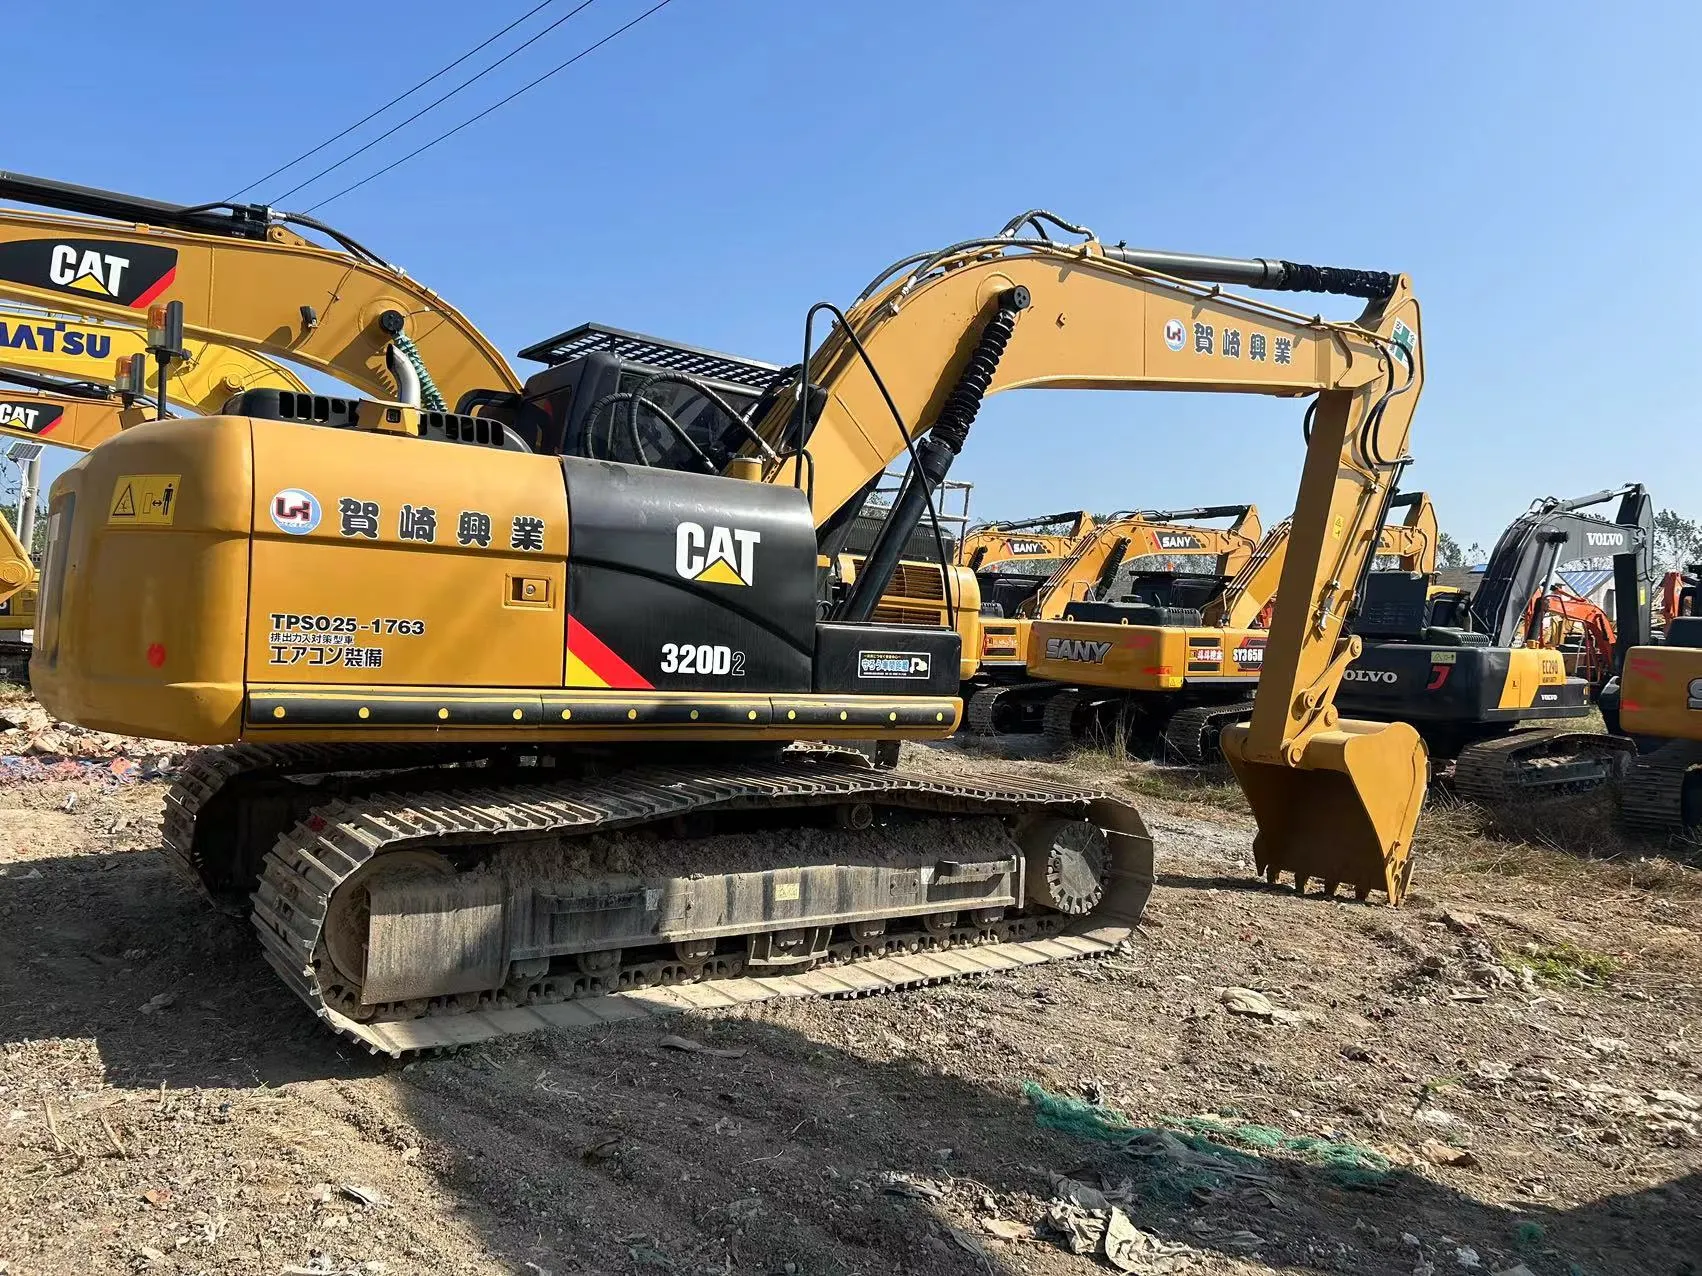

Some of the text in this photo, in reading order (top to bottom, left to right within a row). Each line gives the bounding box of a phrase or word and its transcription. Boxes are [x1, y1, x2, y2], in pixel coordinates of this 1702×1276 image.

[50, 244, 130, 297] CAT
[0, 403, 39, 430] CAT
[338, 497, 545, 551] 賀崎興業
[1013, 543, 1040, 553] SANY
[1162, 534, 1192, 548] SANY
[1586, 532, 1624, 546] VOLVO
[675, 521, 761, 587] CAT
[1045, 637, 1113, 664] SANY
[1343, 669, 1398, 684] OLVO
